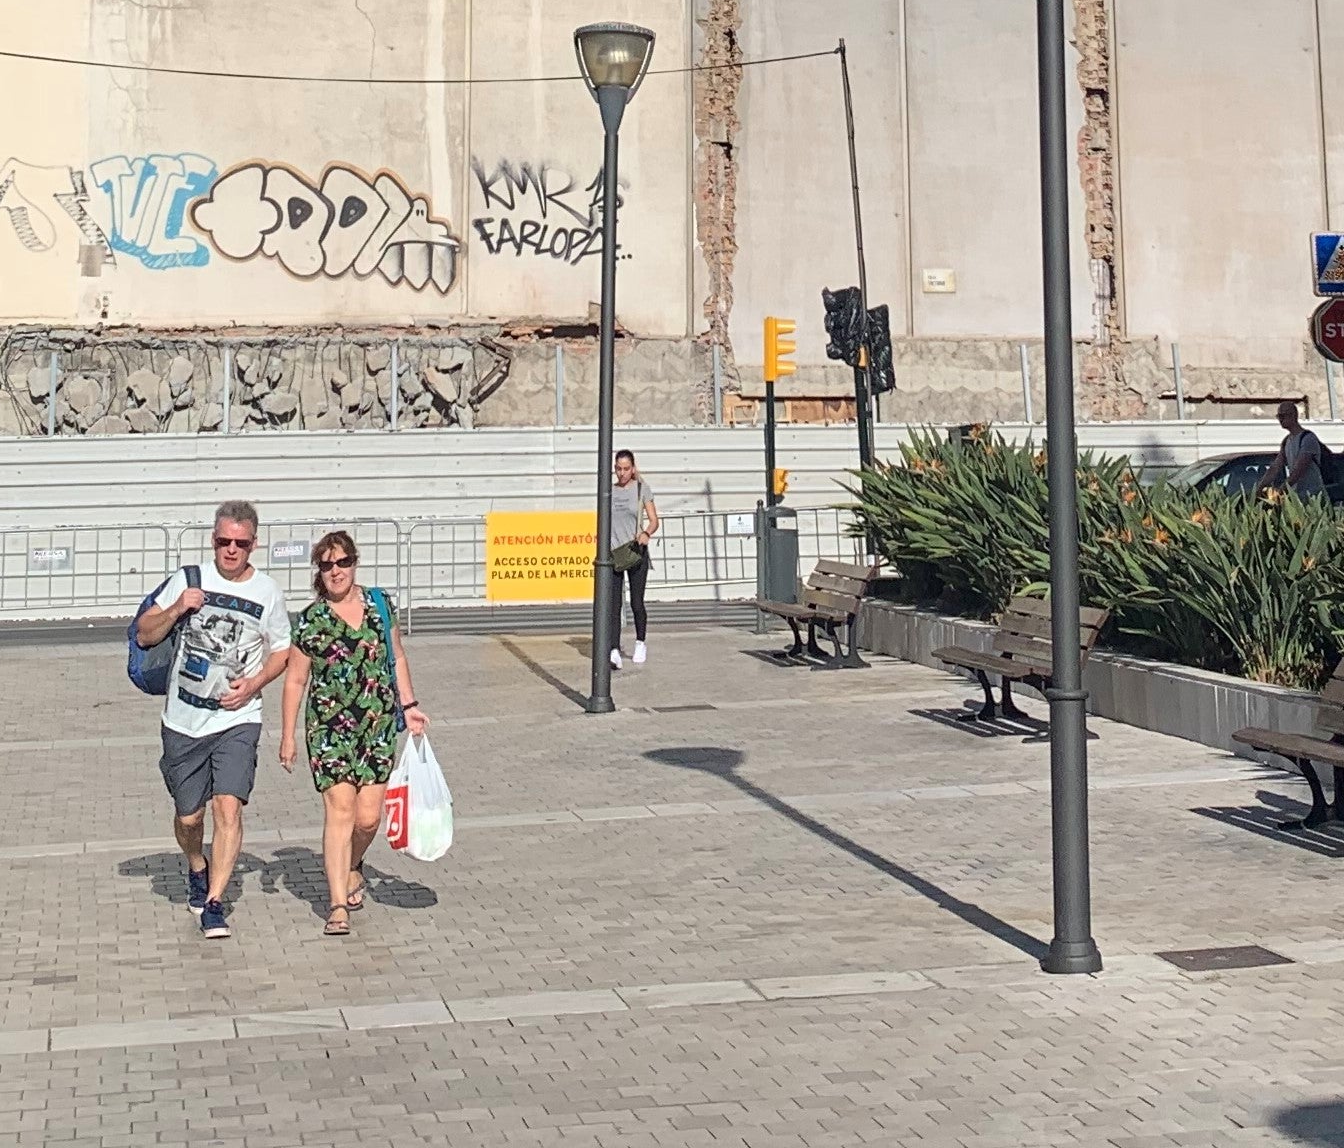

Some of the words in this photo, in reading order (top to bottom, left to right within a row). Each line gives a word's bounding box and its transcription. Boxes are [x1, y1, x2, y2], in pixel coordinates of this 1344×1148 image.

[493, 533, 553, 545] ATENCIÓN
[494, 557, 537, 566] ACCESO
[540, 556, 590, 566] CORTADO
[492, 571, 524, 579] PLAZA
[527, 570, 540, 579] DE
[544, 570, 556, 578] LA
[560, 569, 595, 578] MERCE
[203, 592, 262, 618] SCAPE
